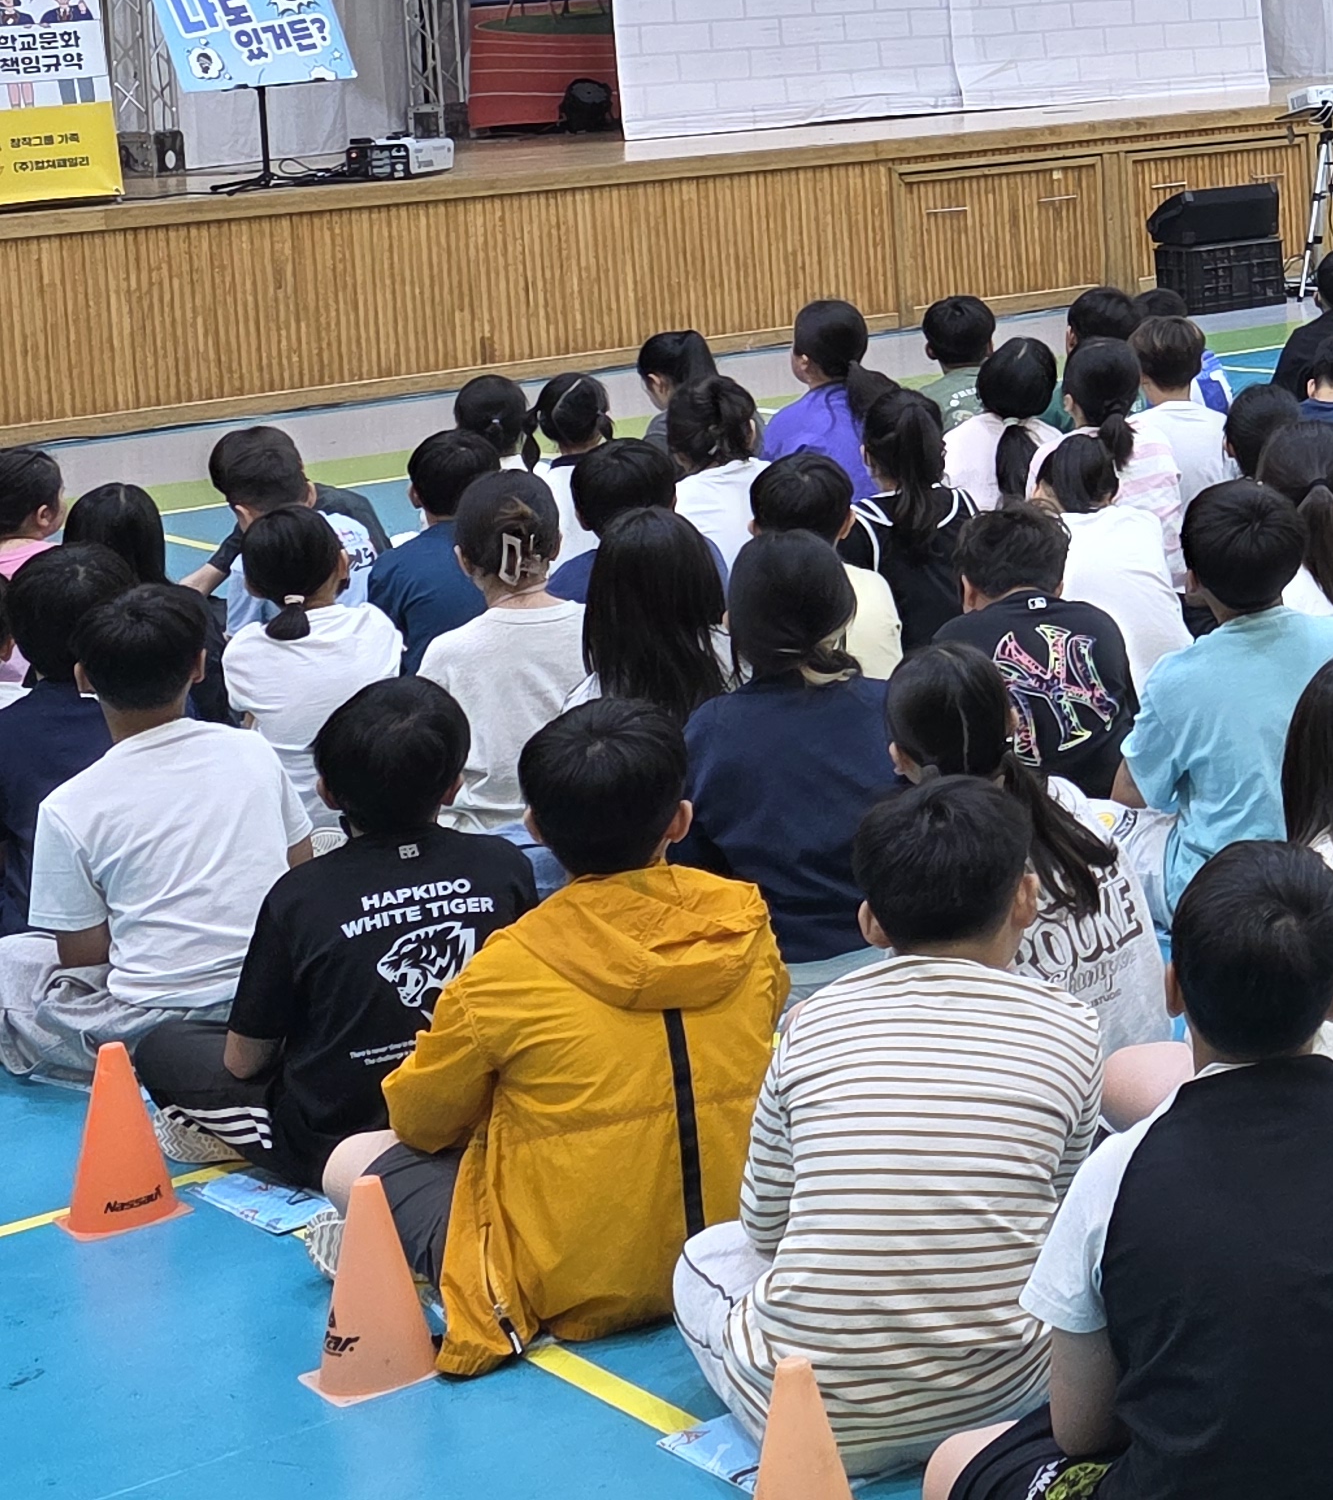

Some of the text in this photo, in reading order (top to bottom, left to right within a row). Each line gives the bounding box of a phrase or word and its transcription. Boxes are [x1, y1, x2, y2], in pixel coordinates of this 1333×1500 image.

[234, 16, 327, 62] 있거든?
[0, 52, 84, 75] 책임규약
[361, 878, 471, 911] HAPKIDO
[340, 896, 495, 939] WHITE TIGER
